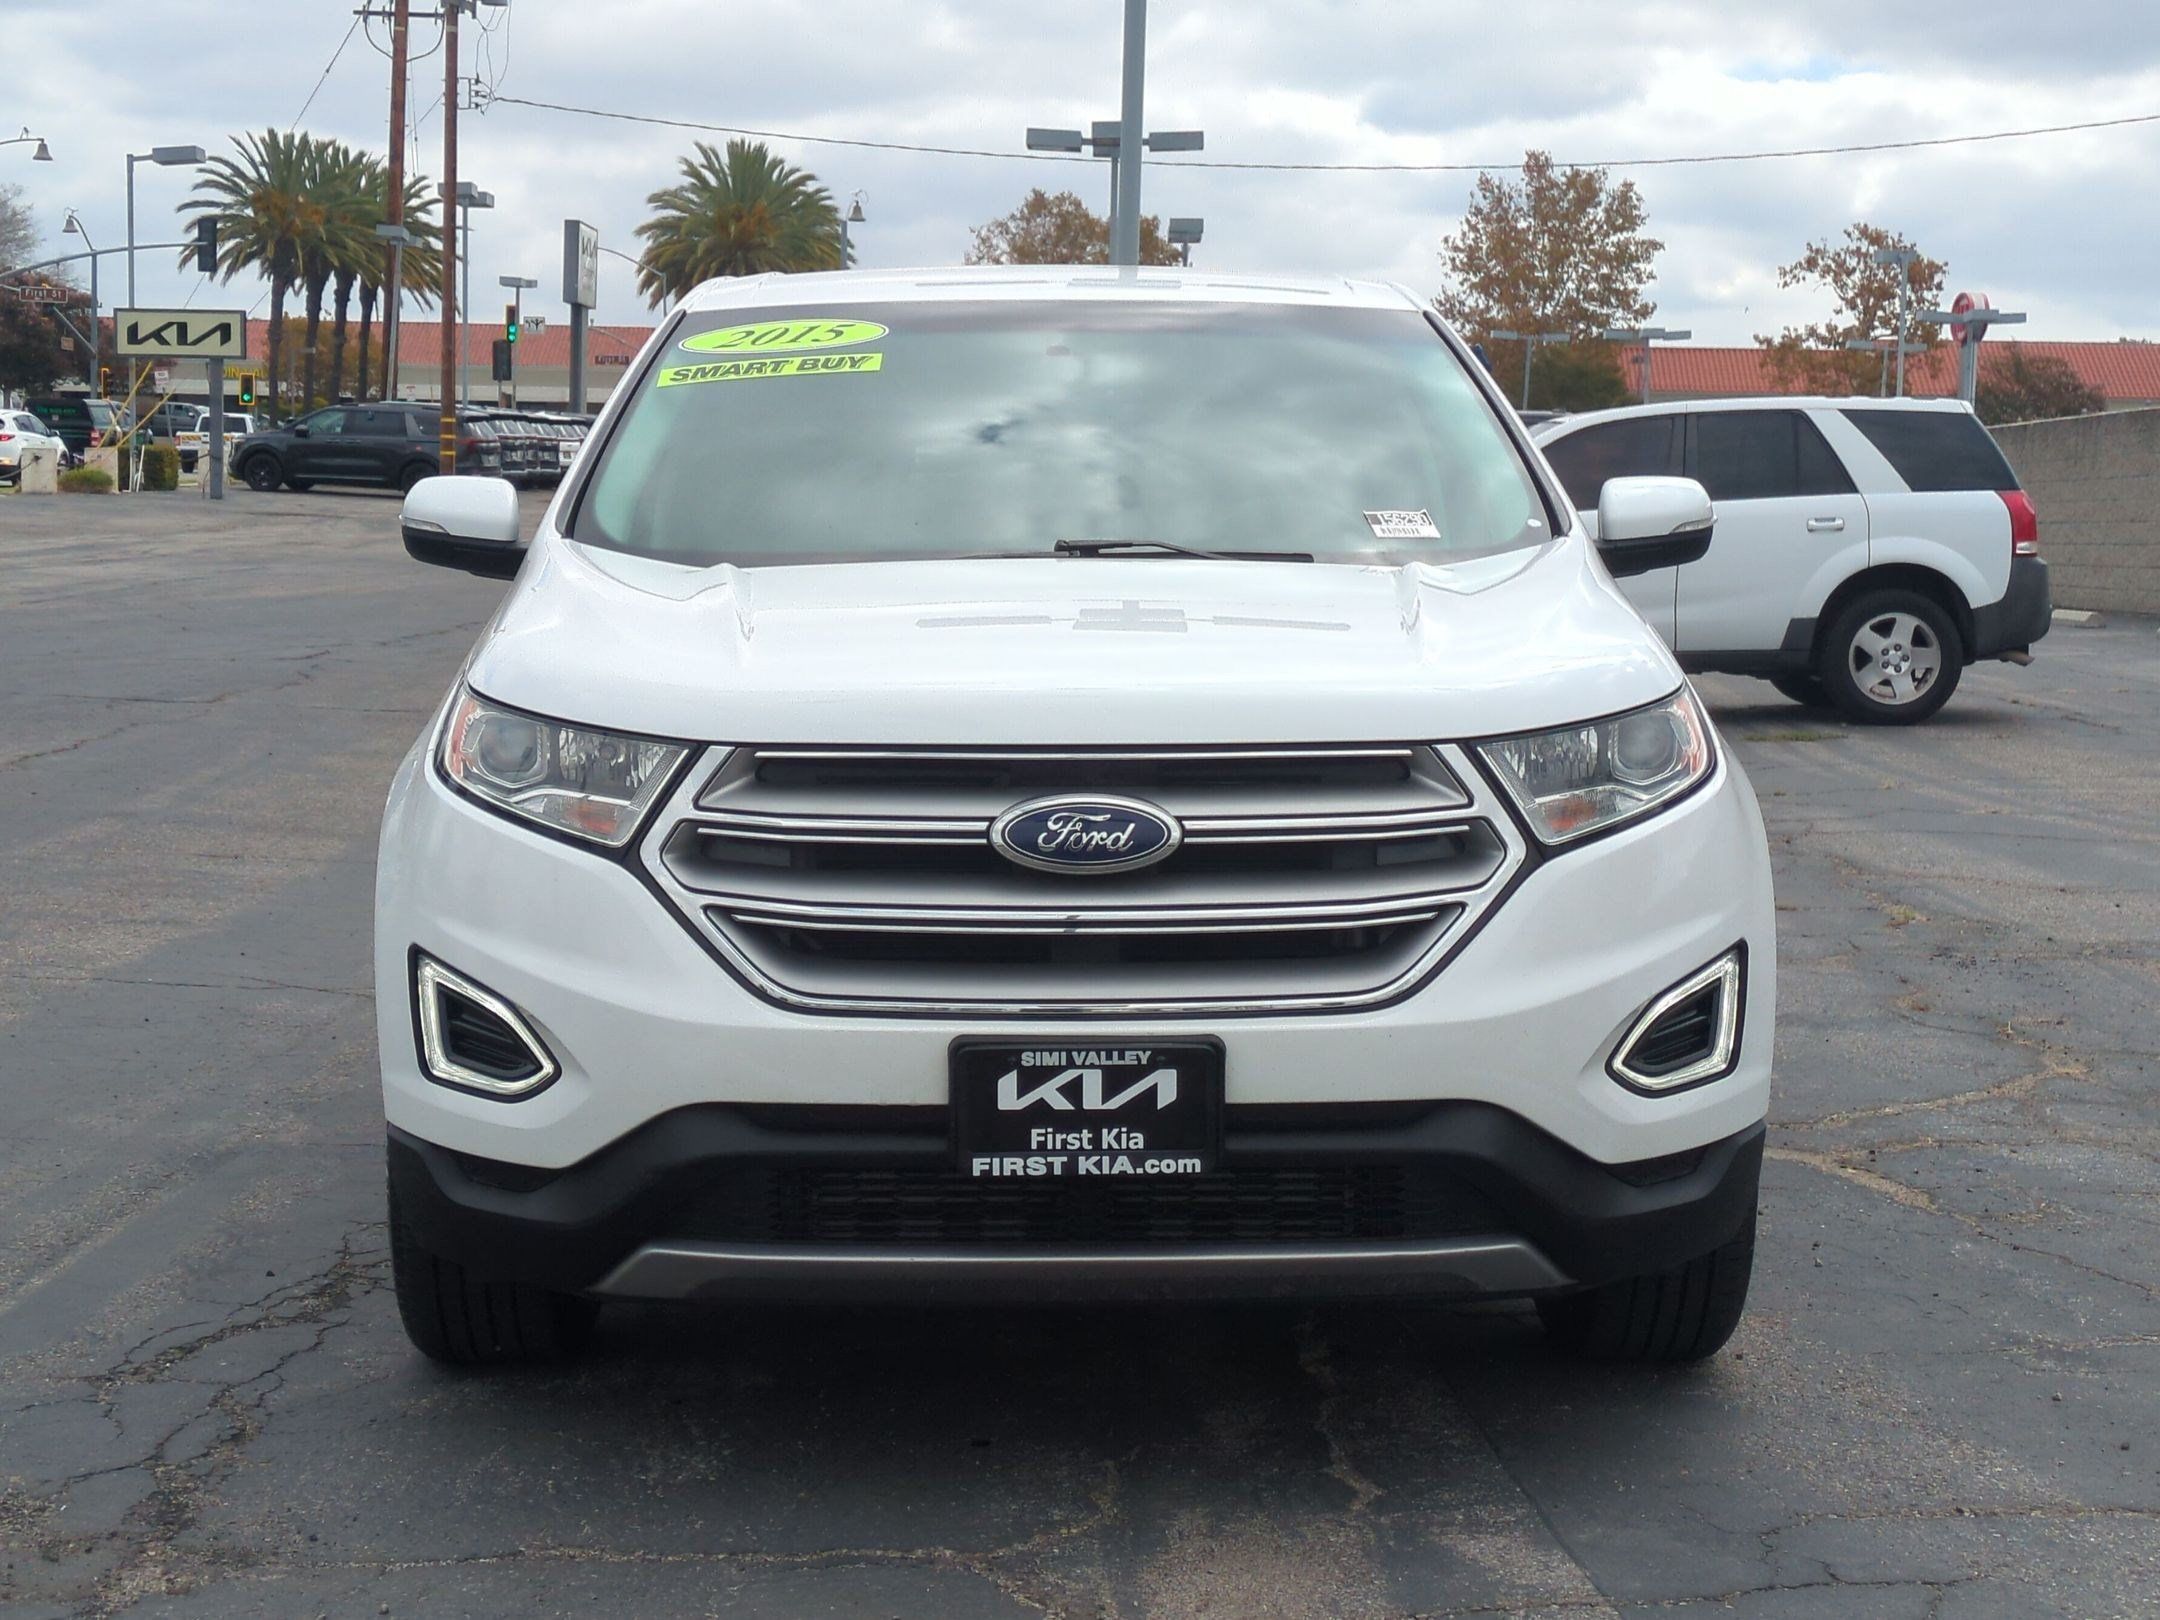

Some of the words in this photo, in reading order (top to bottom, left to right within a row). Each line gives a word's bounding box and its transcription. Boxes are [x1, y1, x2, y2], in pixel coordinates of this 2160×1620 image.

[25, 289, 47, 298] First
[52, 290, 63, 298] St
[127, 321, 231, 347] KIA
[711, 324, 857, 349] 2015
[669, 359, 793, 382] SMART
[796, 355, 873, 372] BUY
[1037, 812, 1136, 851] Ford
[1020, 1051, 1067, 1067] SIMI
[1071, 1050, 1152, 1066] VALLEY
[997, 1068, 1178, 1111] KIA
[1030, 1128, 1093, 1150] First
[1101, 1128, 1145, 1150] Kia
[972, 1156, 1067, 1177] FIRST
[1077, 1155, 1201, 1175] KIA.com
